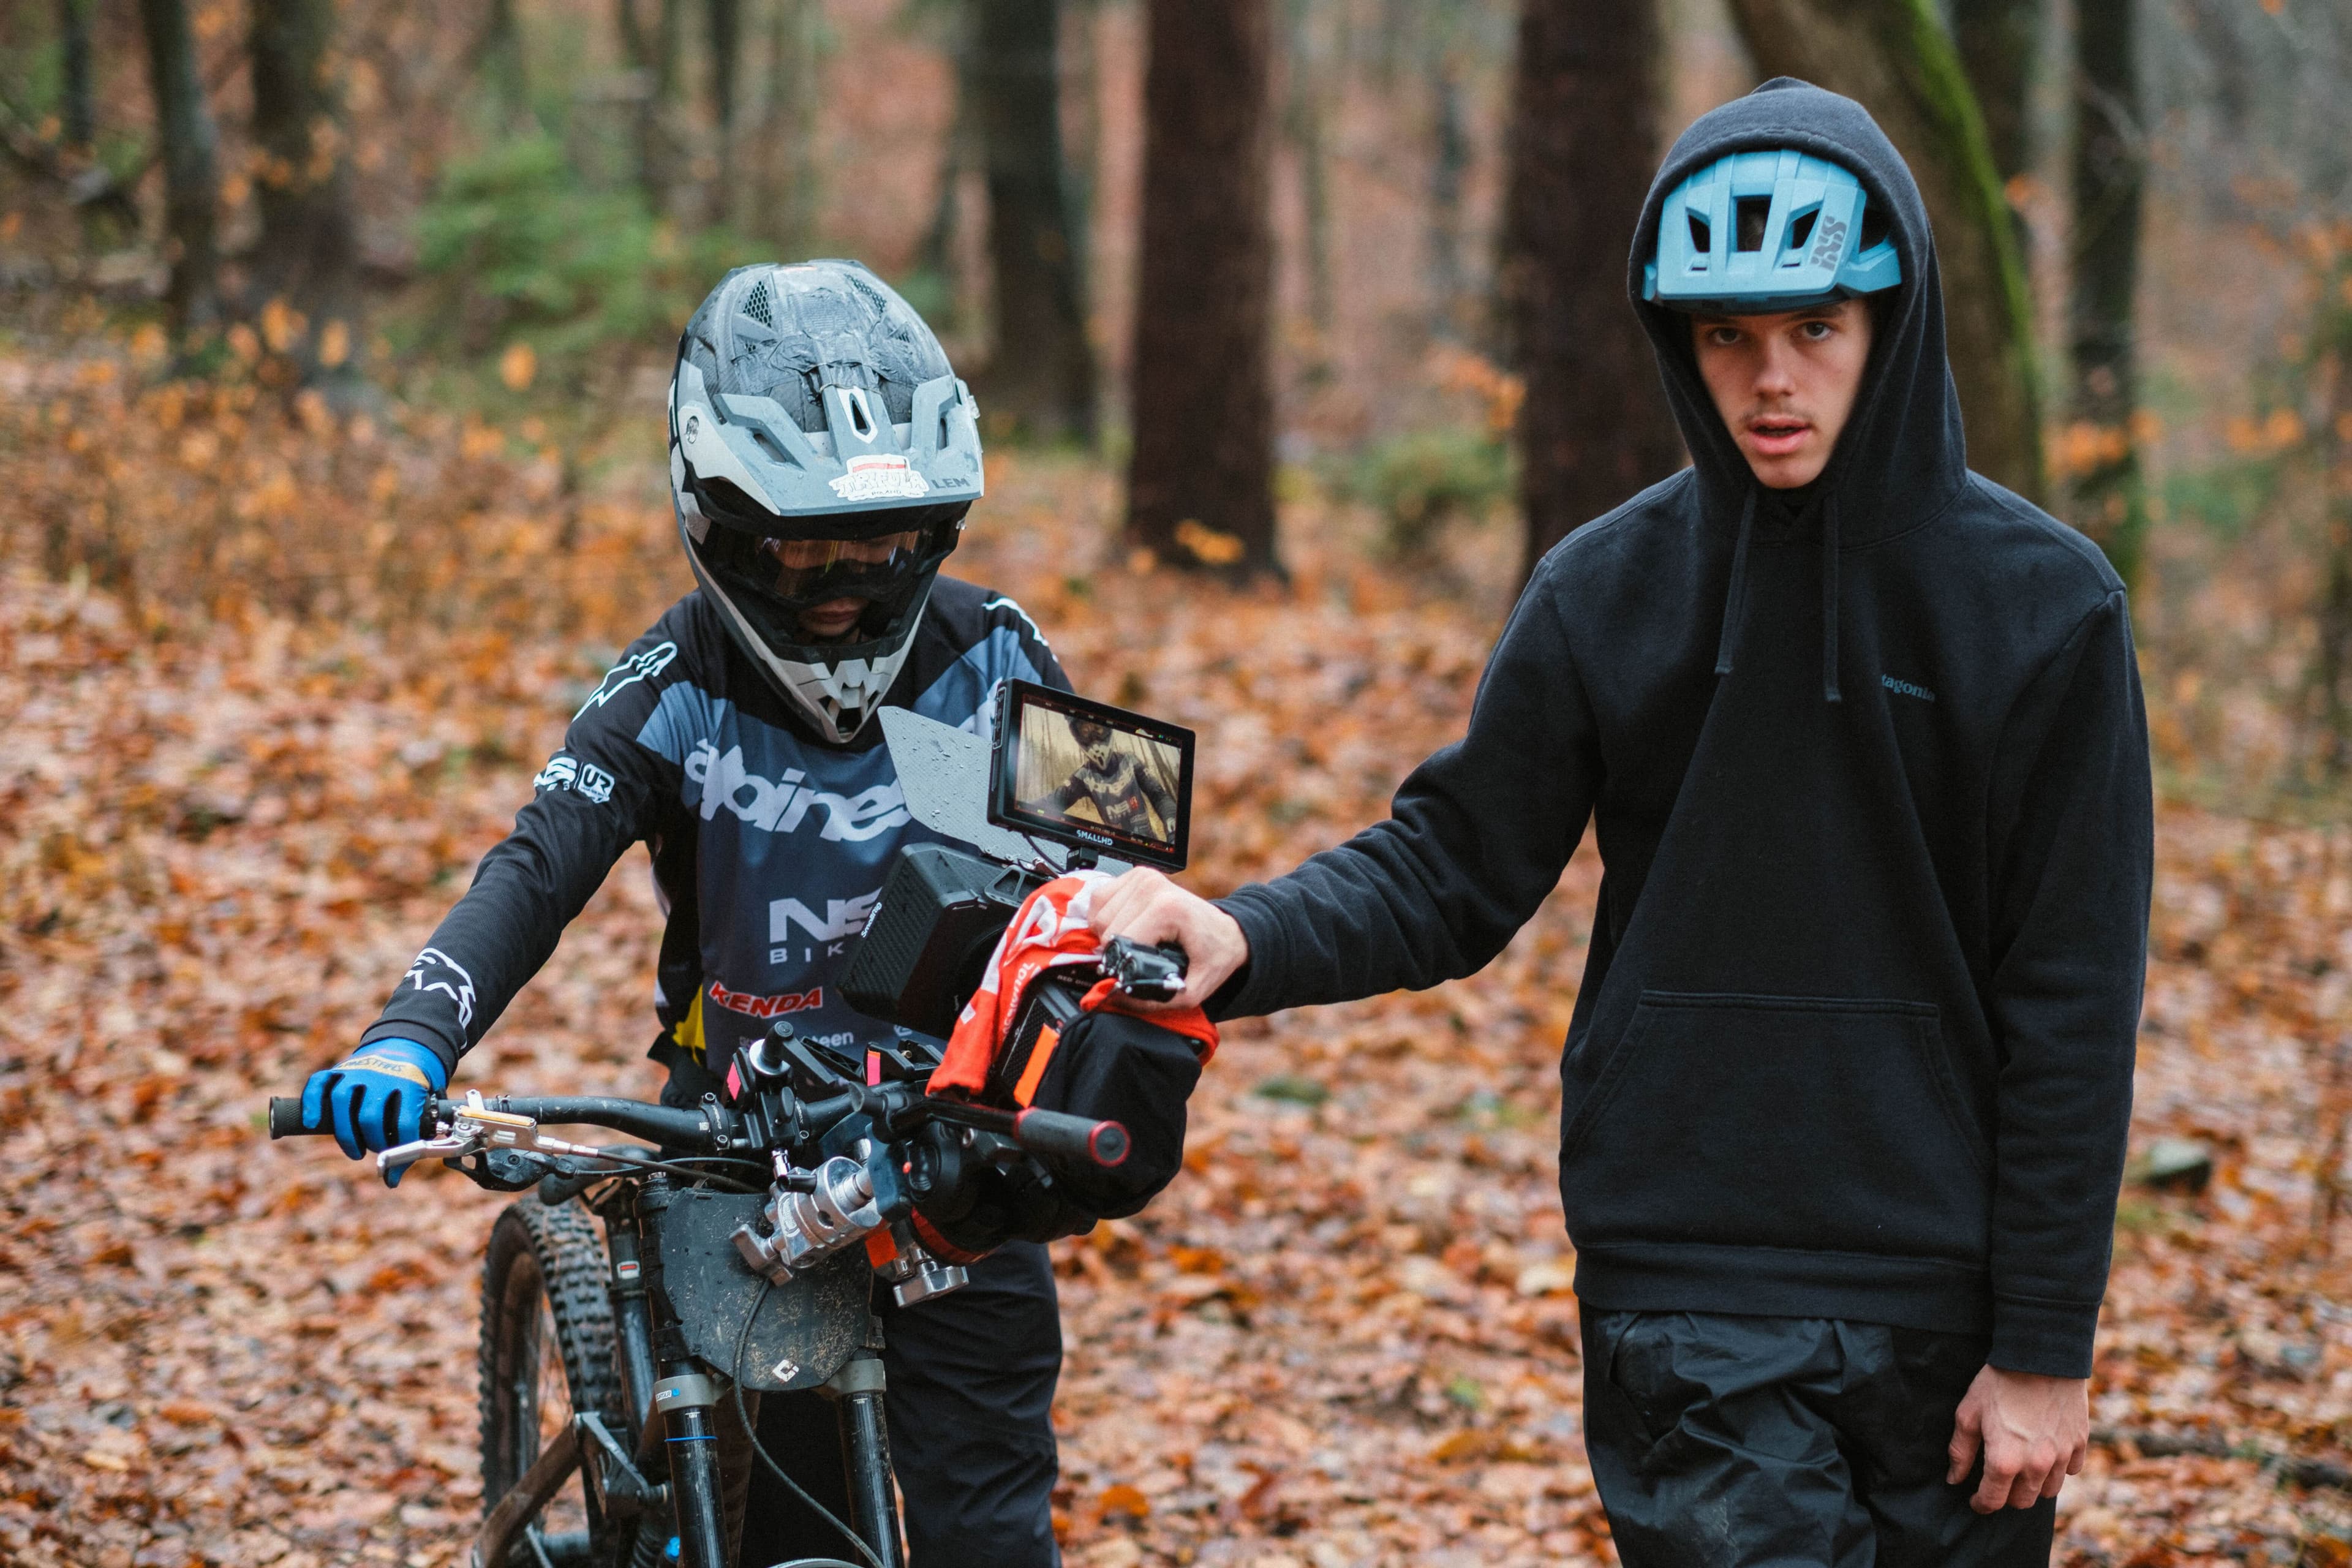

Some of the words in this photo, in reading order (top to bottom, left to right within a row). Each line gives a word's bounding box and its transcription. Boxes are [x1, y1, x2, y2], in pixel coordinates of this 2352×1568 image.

[930, 477, 971, 489] LEM
[1076, 829, 1114, 846] SMALLHD
[709, 981, 824, 1019] KENDA
